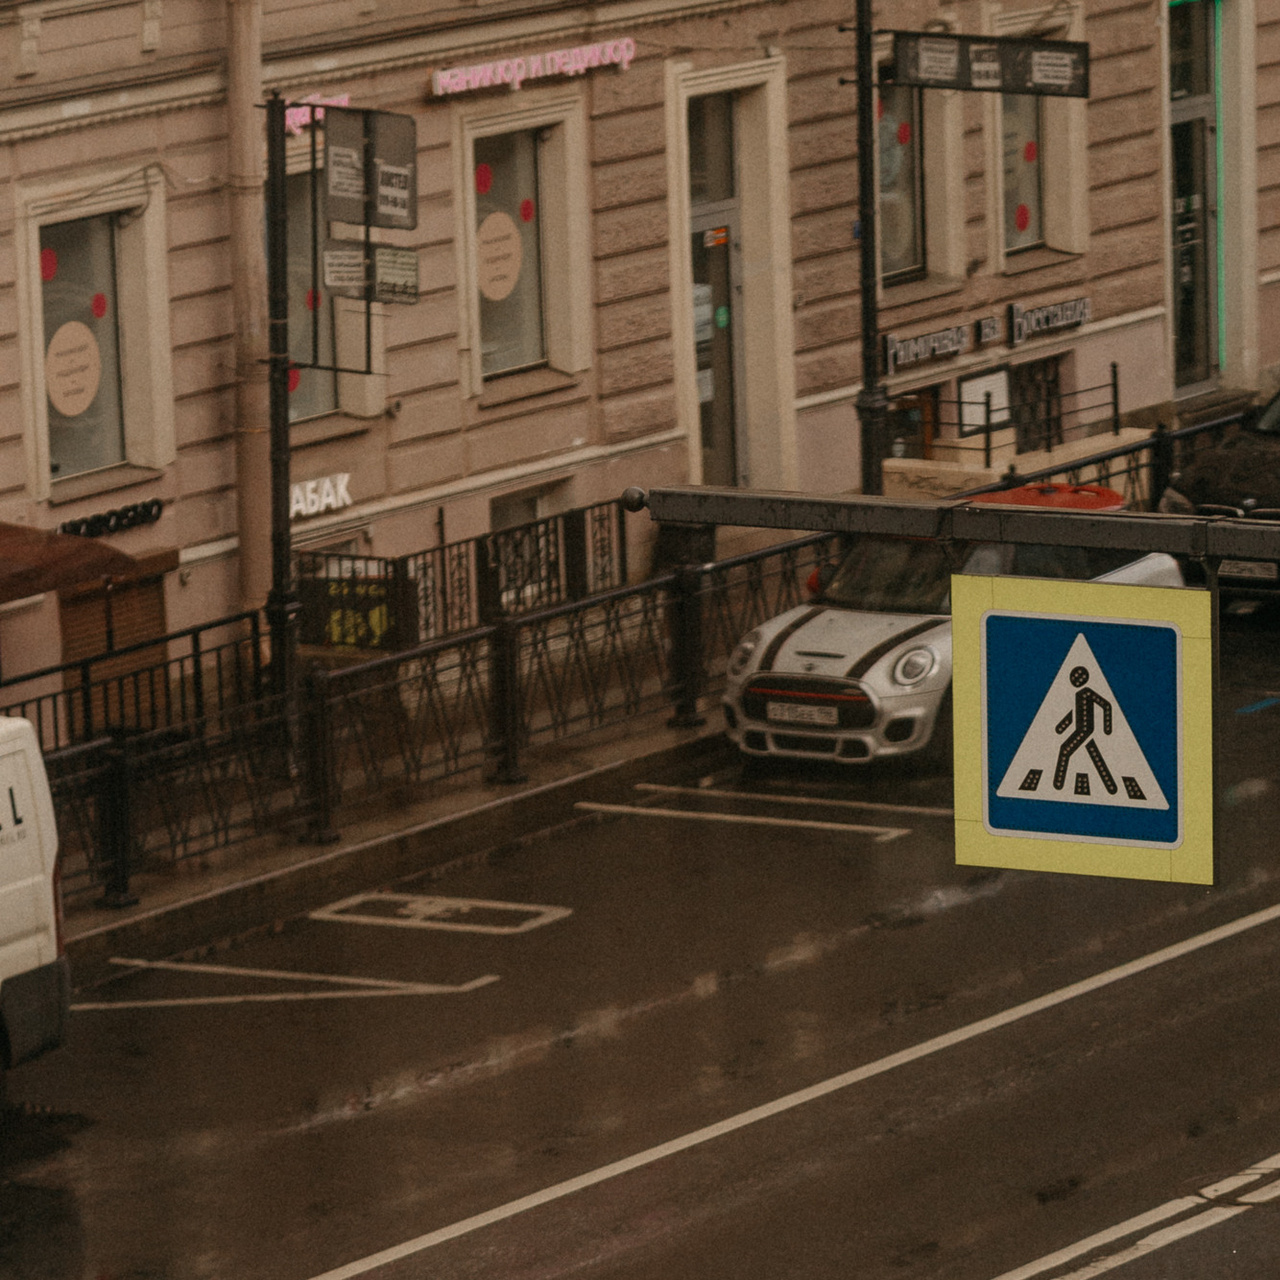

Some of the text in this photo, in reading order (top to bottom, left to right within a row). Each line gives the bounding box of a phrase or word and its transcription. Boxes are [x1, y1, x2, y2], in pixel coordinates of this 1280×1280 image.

[433, 37, 636, 95] маникюр и педикюр
[289, 472, 353, 519] АБАК
